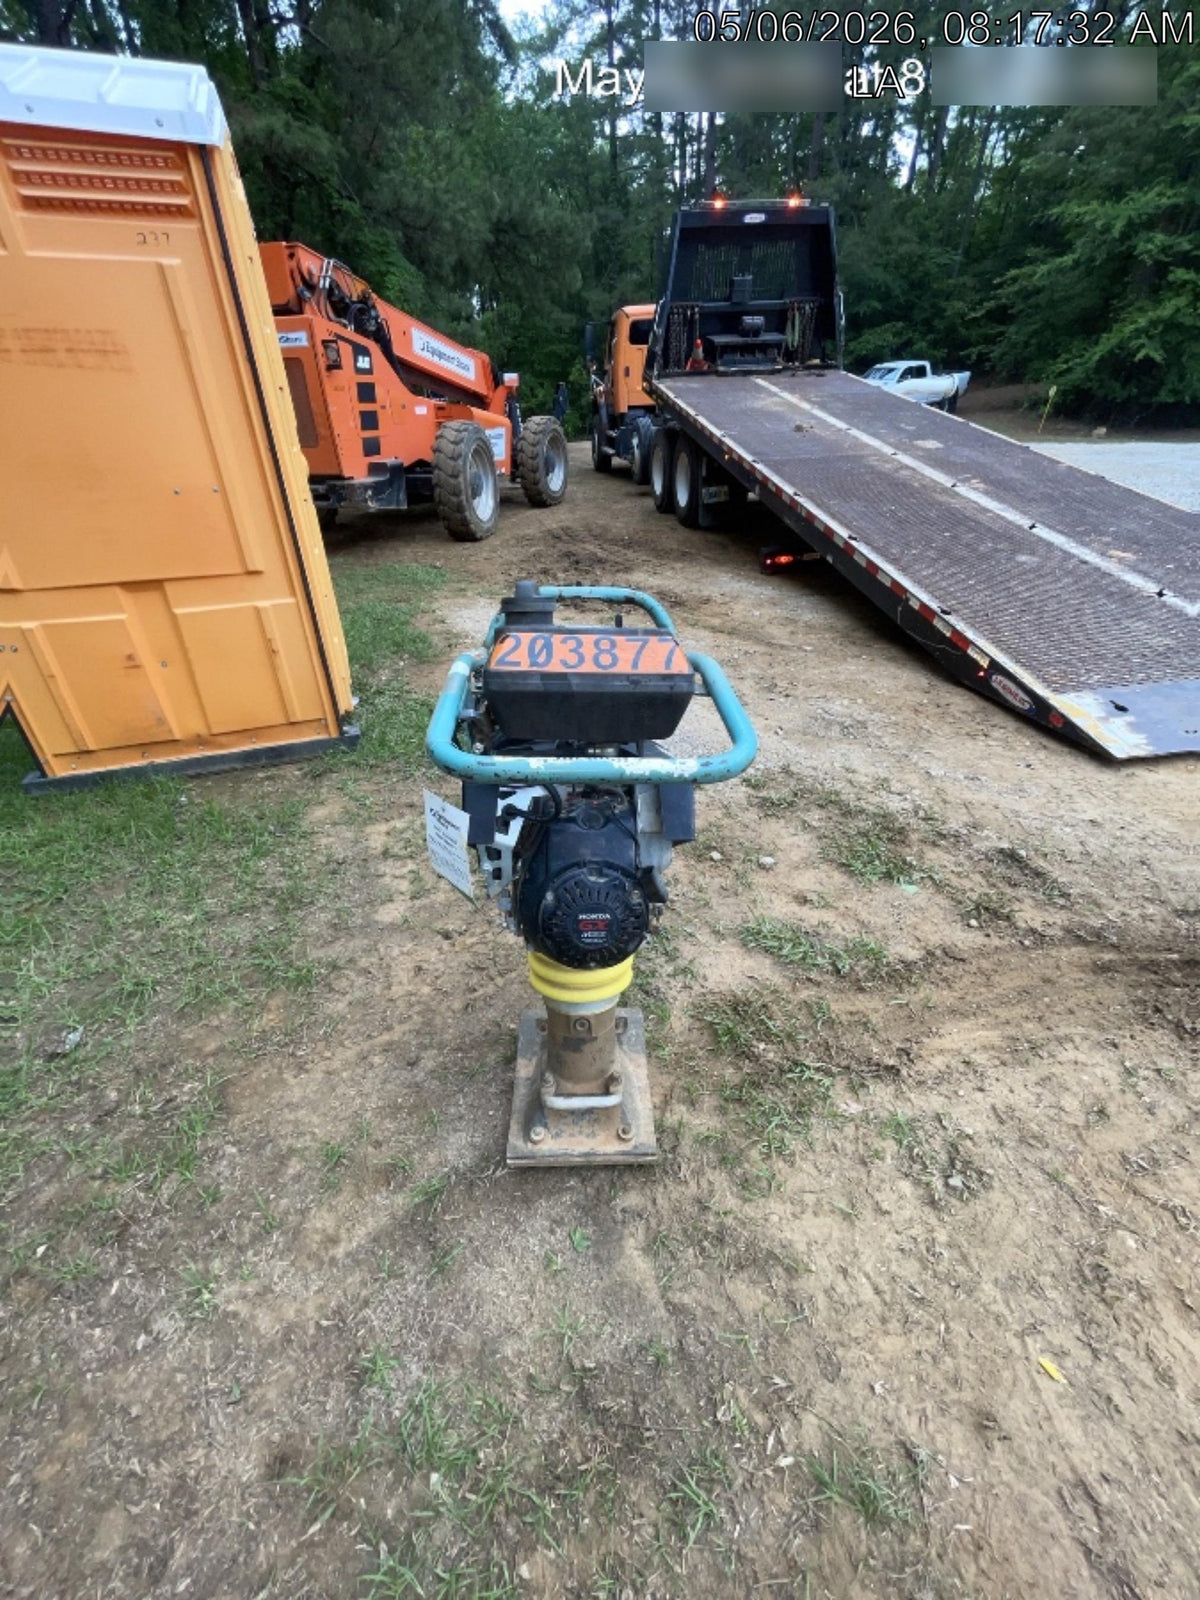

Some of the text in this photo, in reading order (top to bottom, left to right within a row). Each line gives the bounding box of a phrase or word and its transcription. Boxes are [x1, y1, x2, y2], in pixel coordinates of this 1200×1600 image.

[494, 633, 679, 671] 203877
[578, 912, 612, 920] HONDA
[579, 920, 609, 931] GX
